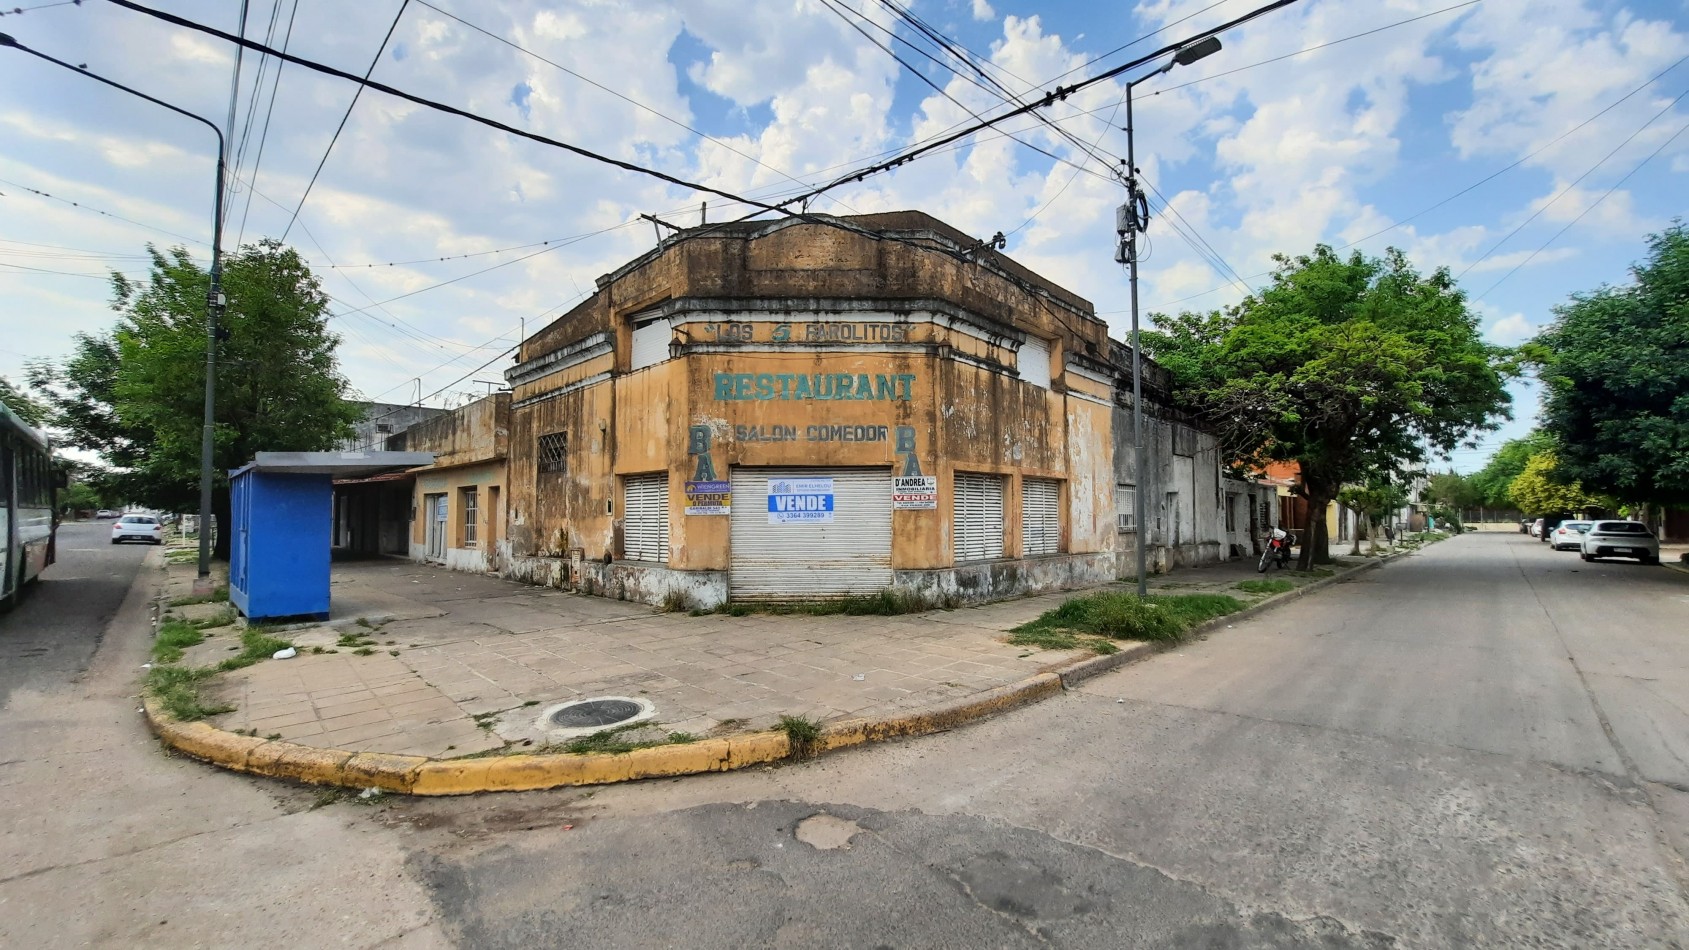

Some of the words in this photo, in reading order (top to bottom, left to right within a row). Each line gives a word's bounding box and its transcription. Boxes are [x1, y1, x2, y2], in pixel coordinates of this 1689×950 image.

[771, 323, 793, 342] 5
[714, 373, 916, 401] RESTAURANT
[736, 425, 797, 442] SALON
[806, 425, 889, 442] COMEDOR
[895, 478, 926, 487] D'ANDREA
[776, 496, 826, 510] VENDE
